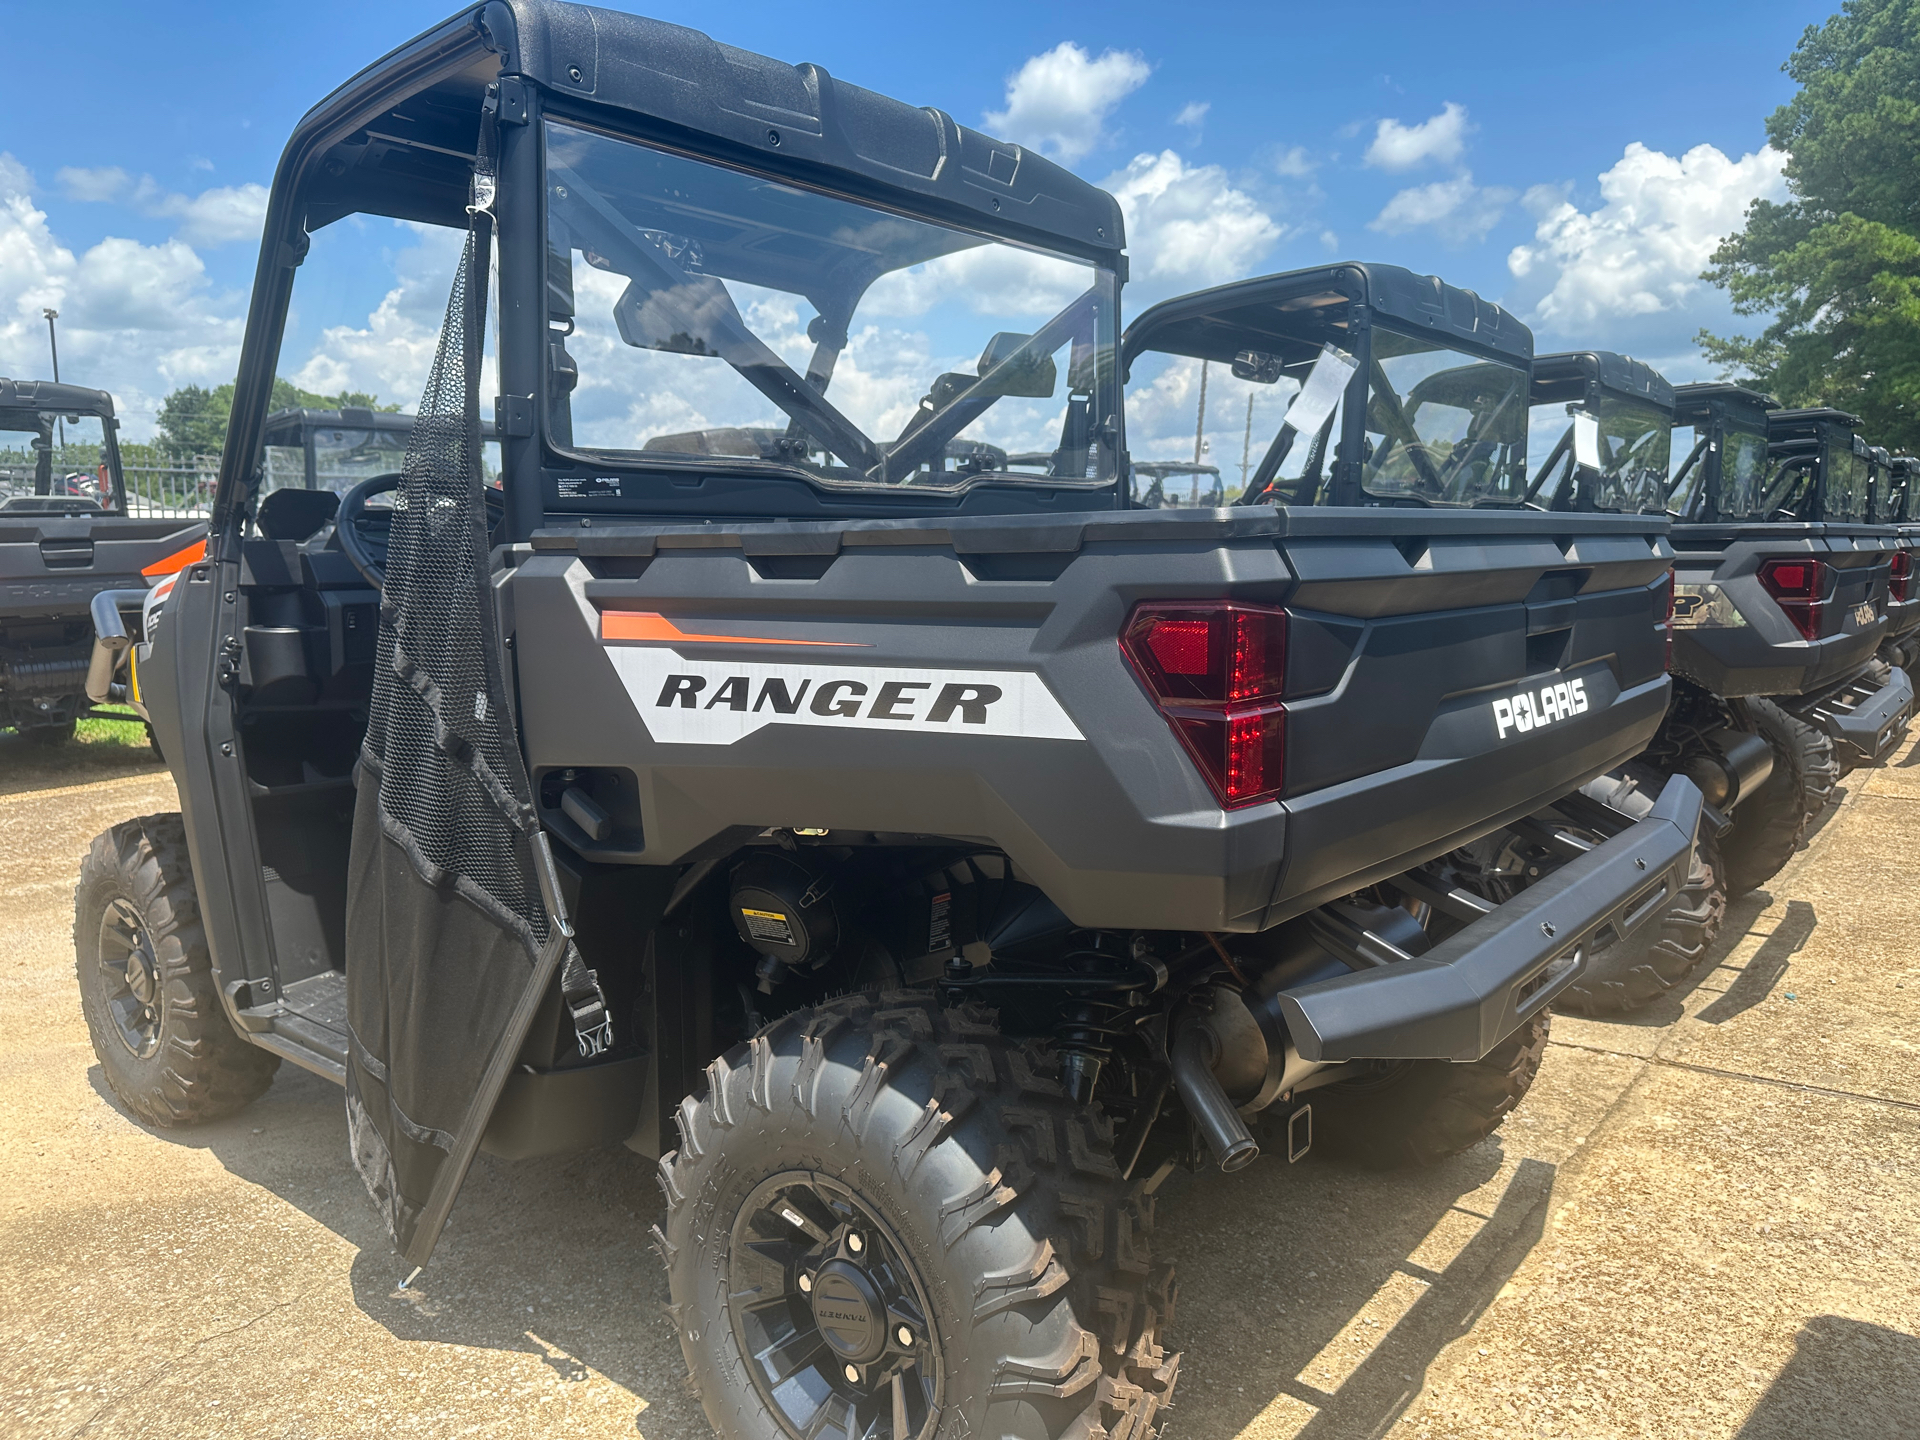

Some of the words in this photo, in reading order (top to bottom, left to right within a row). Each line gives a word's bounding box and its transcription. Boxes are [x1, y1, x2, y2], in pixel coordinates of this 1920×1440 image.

[1854, 604, 1875, 627] POLARIS
[655, 674, 1003, 725] RANGER
[1491, 677, 1589, 740] POLARIS
[818, 1309, 867, 1323] RANGER
